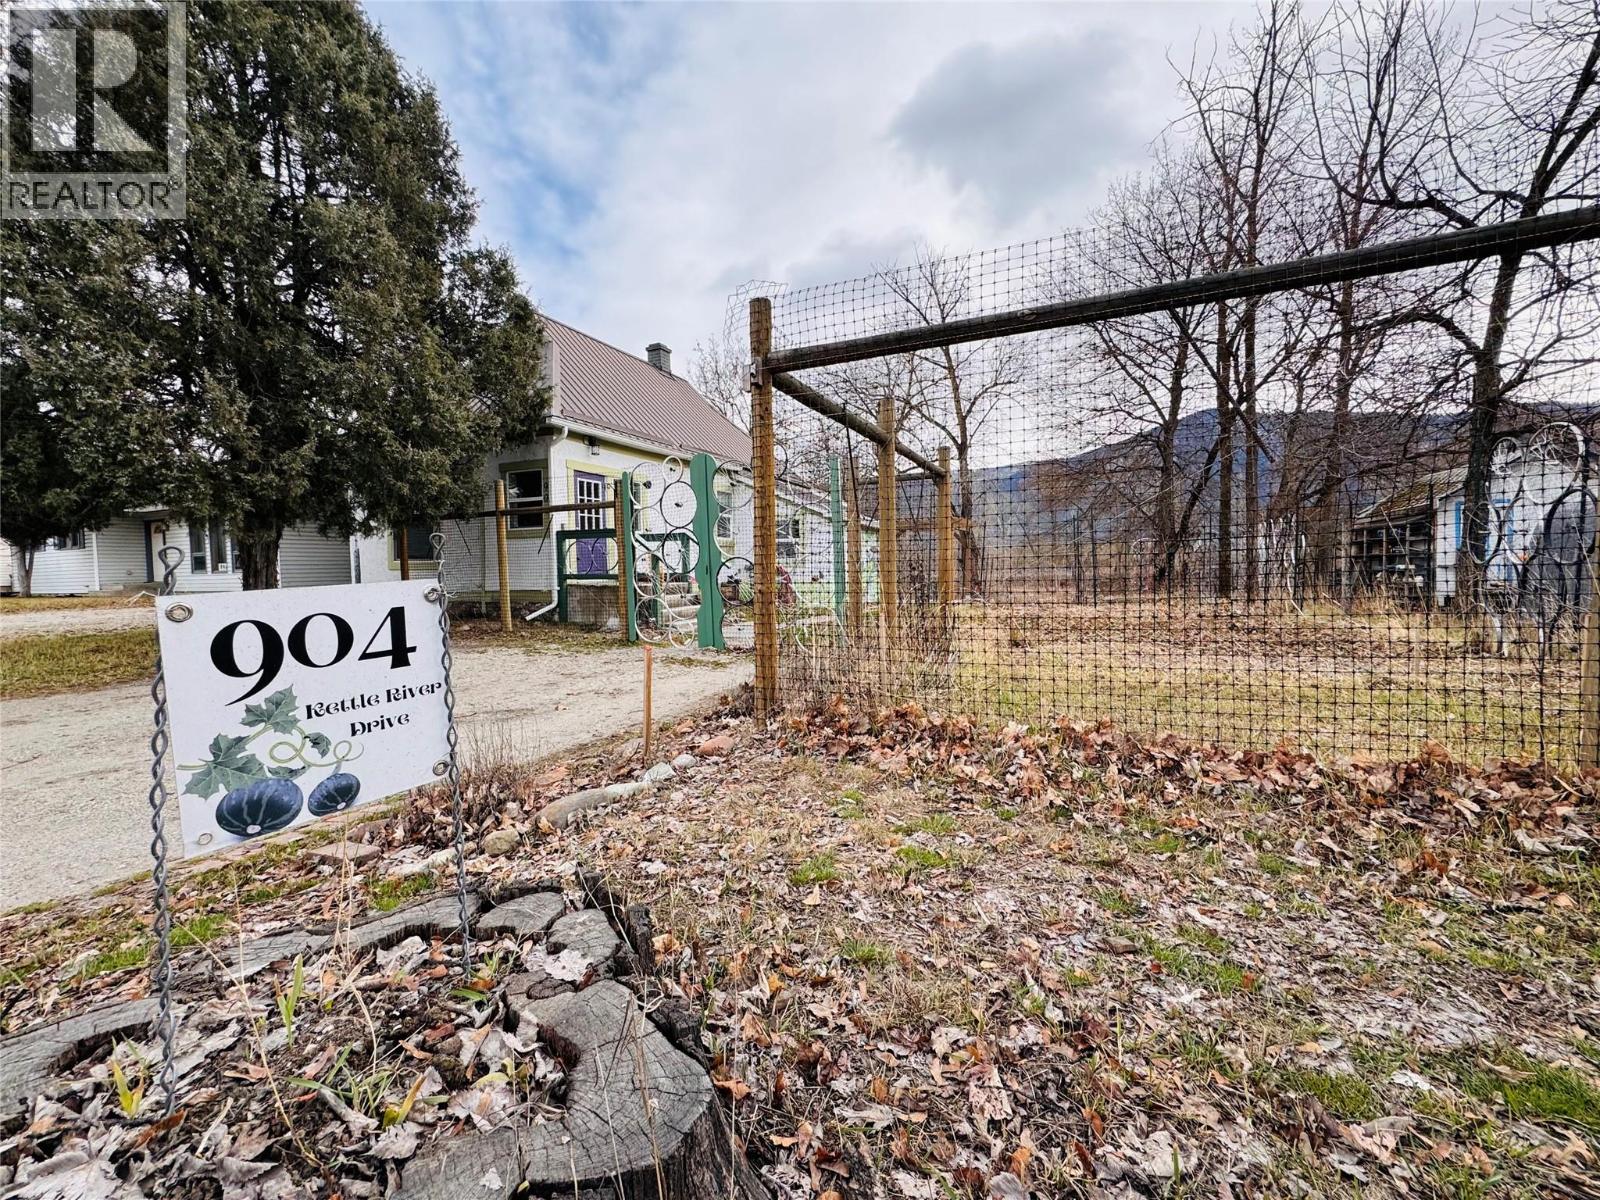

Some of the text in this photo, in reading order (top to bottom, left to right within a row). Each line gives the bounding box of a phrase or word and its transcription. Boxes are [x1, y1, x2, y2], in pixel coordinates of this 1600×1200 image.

[210, 606, 417, 706] 904
[305, 682, 442, 720] Kettle River
[350, 713, 410, 737] Drive
